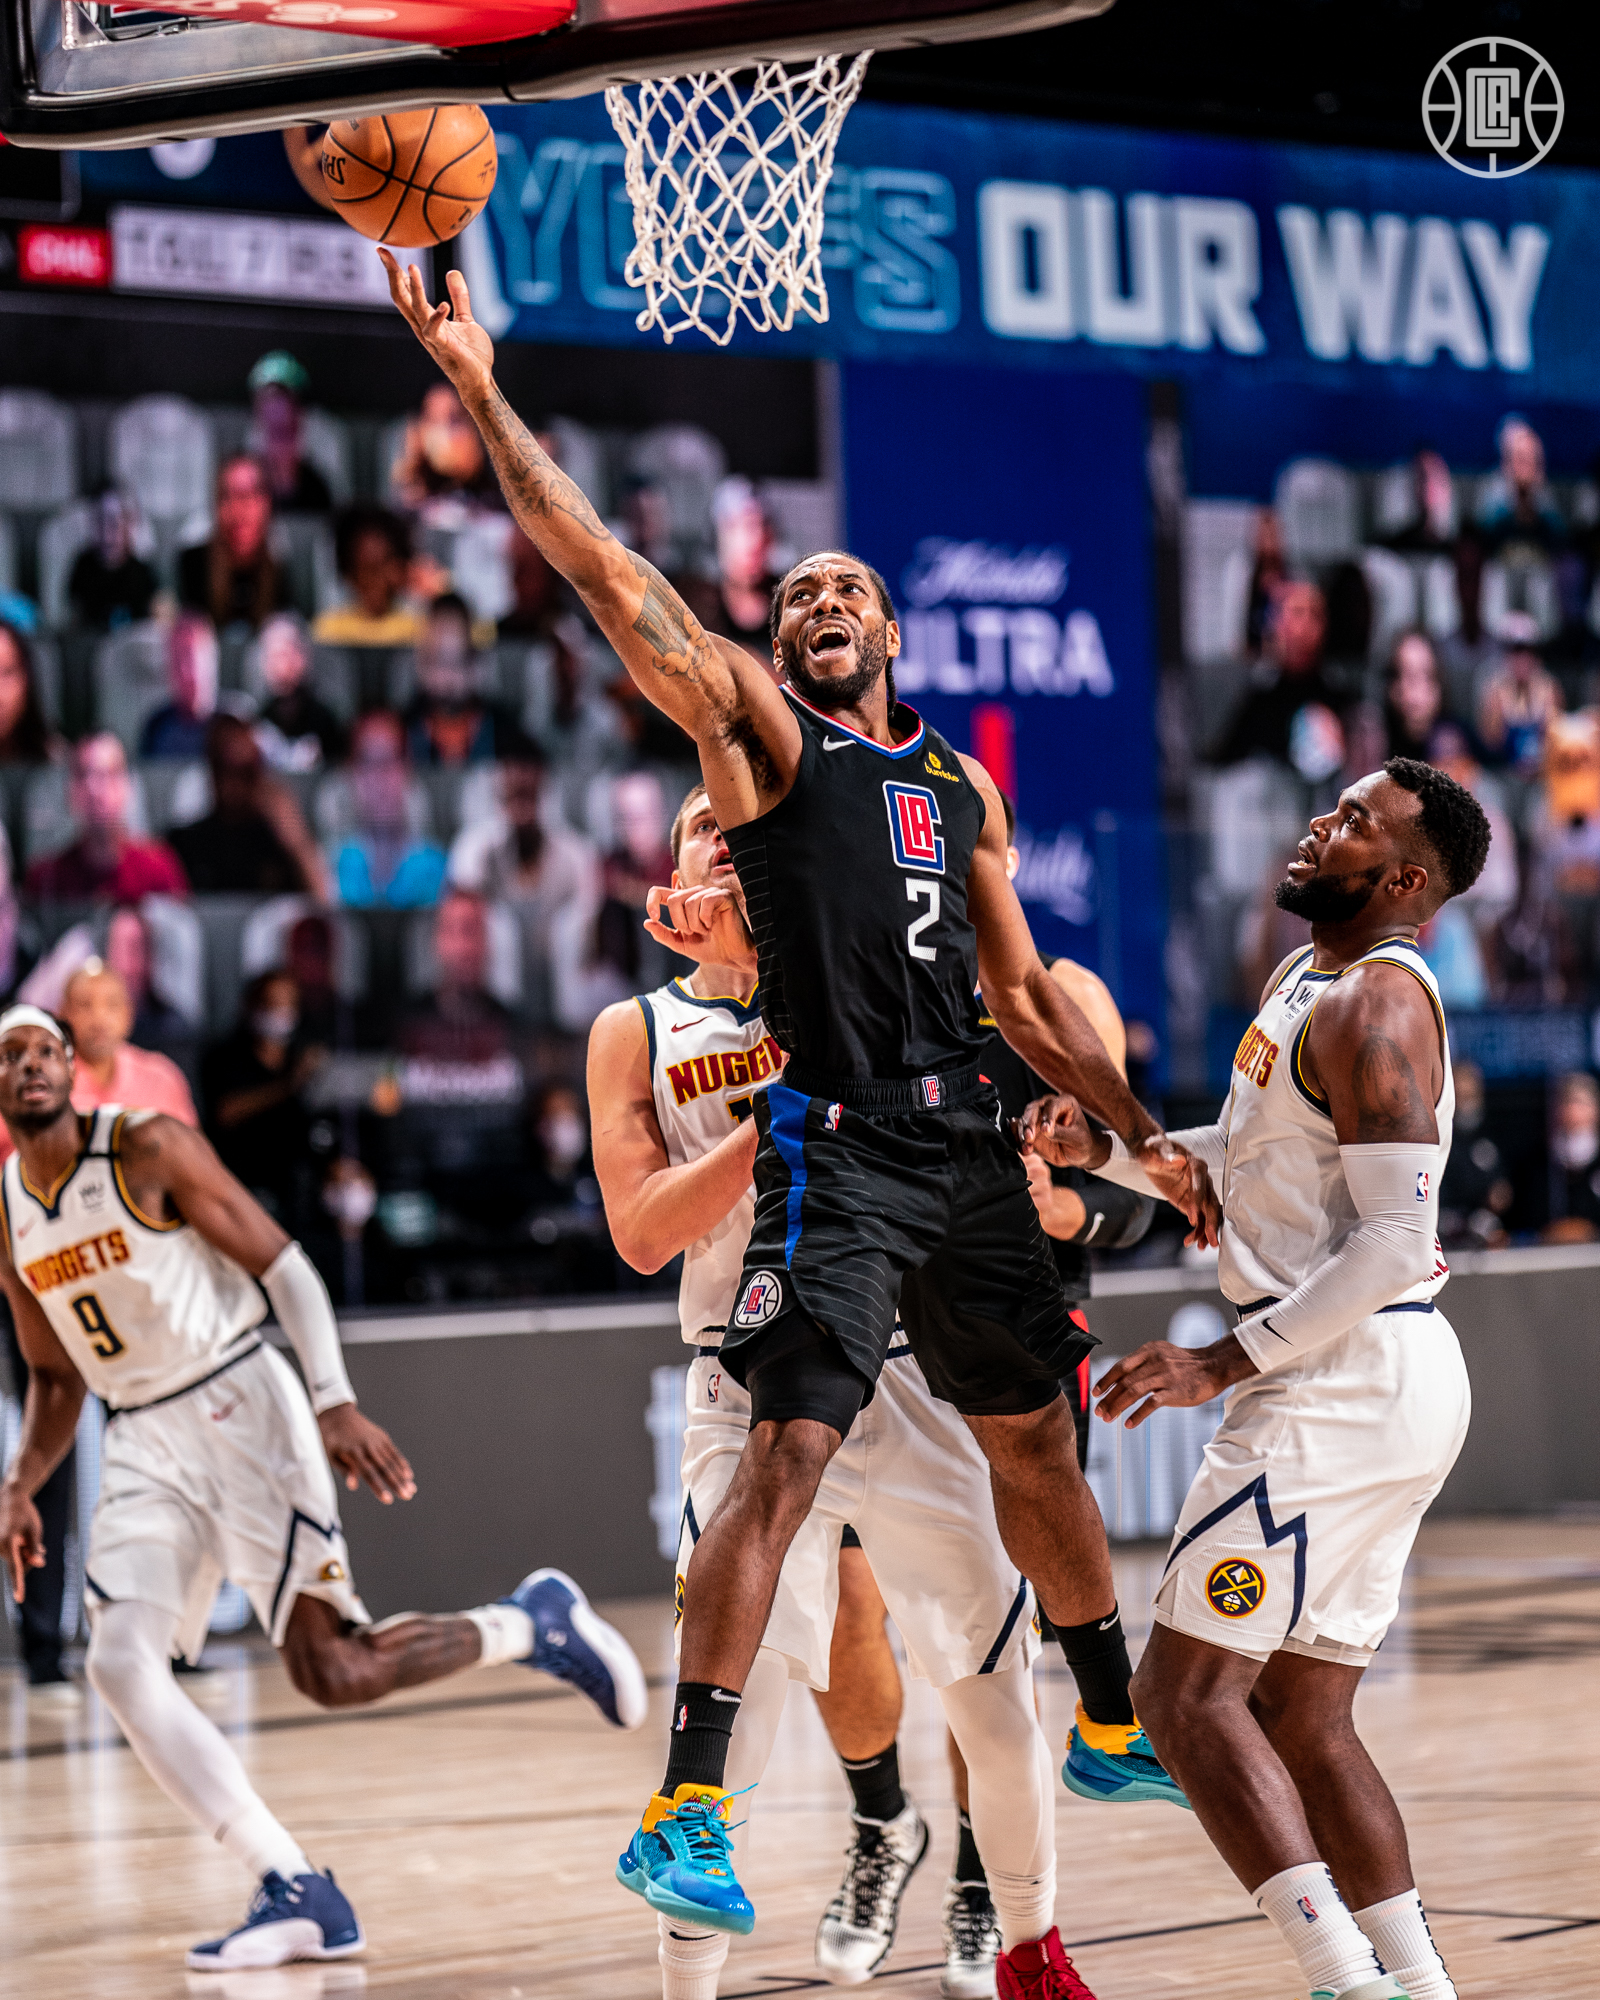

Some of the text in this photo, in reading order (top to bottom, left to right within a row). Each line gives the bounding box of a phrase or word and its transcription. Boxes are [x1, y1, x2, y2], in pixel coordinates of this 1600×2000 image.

[977, 178, 1268, 357] OUR
[1275, 203, 1551, 373] WAY
[905, 877, 941, 962] 2
[69, 1291, 128, 1364] 9
